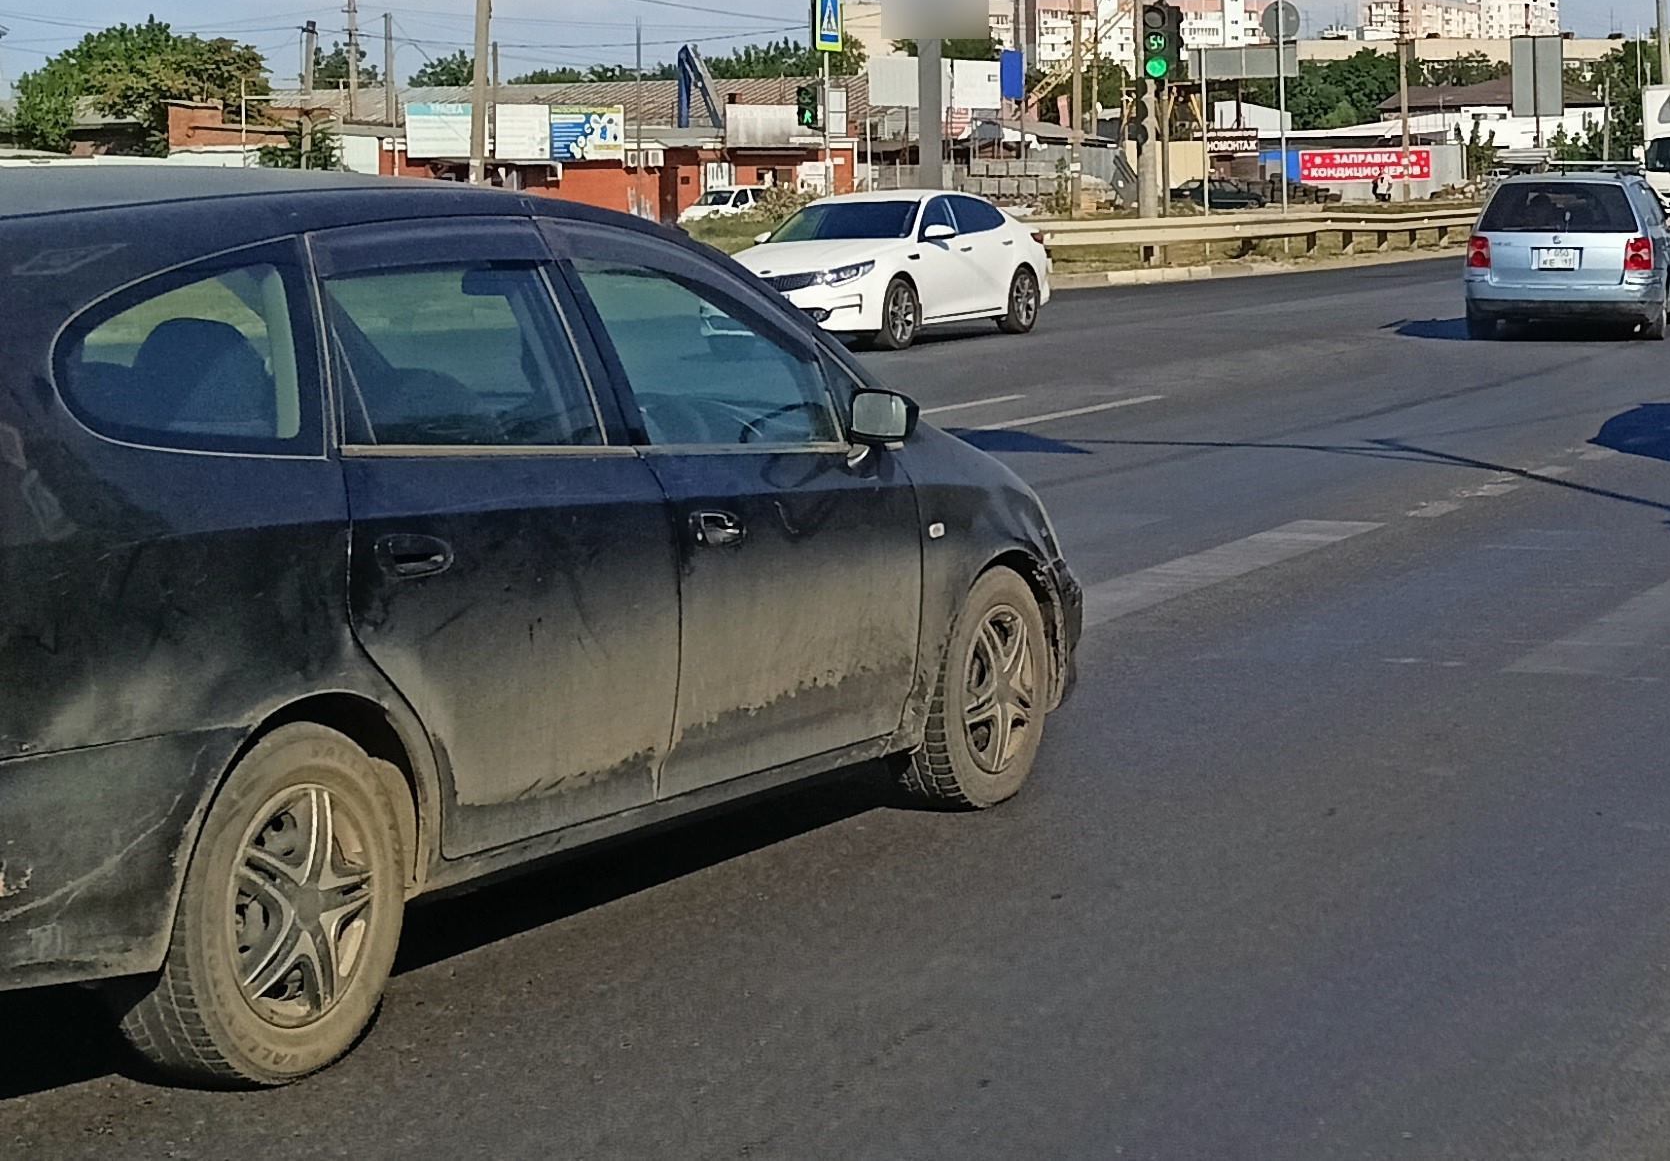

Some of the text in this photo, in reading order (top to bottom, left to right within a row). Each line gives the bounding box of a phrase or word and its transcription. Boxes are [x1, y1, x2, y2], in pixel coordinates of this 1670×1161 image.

[1149, 35, 1165, 50] 54
[1207, 140, 1257, 151] НОМОНТАЖ
[1333, 153, 1398, 164] ЗАПРАВКА
